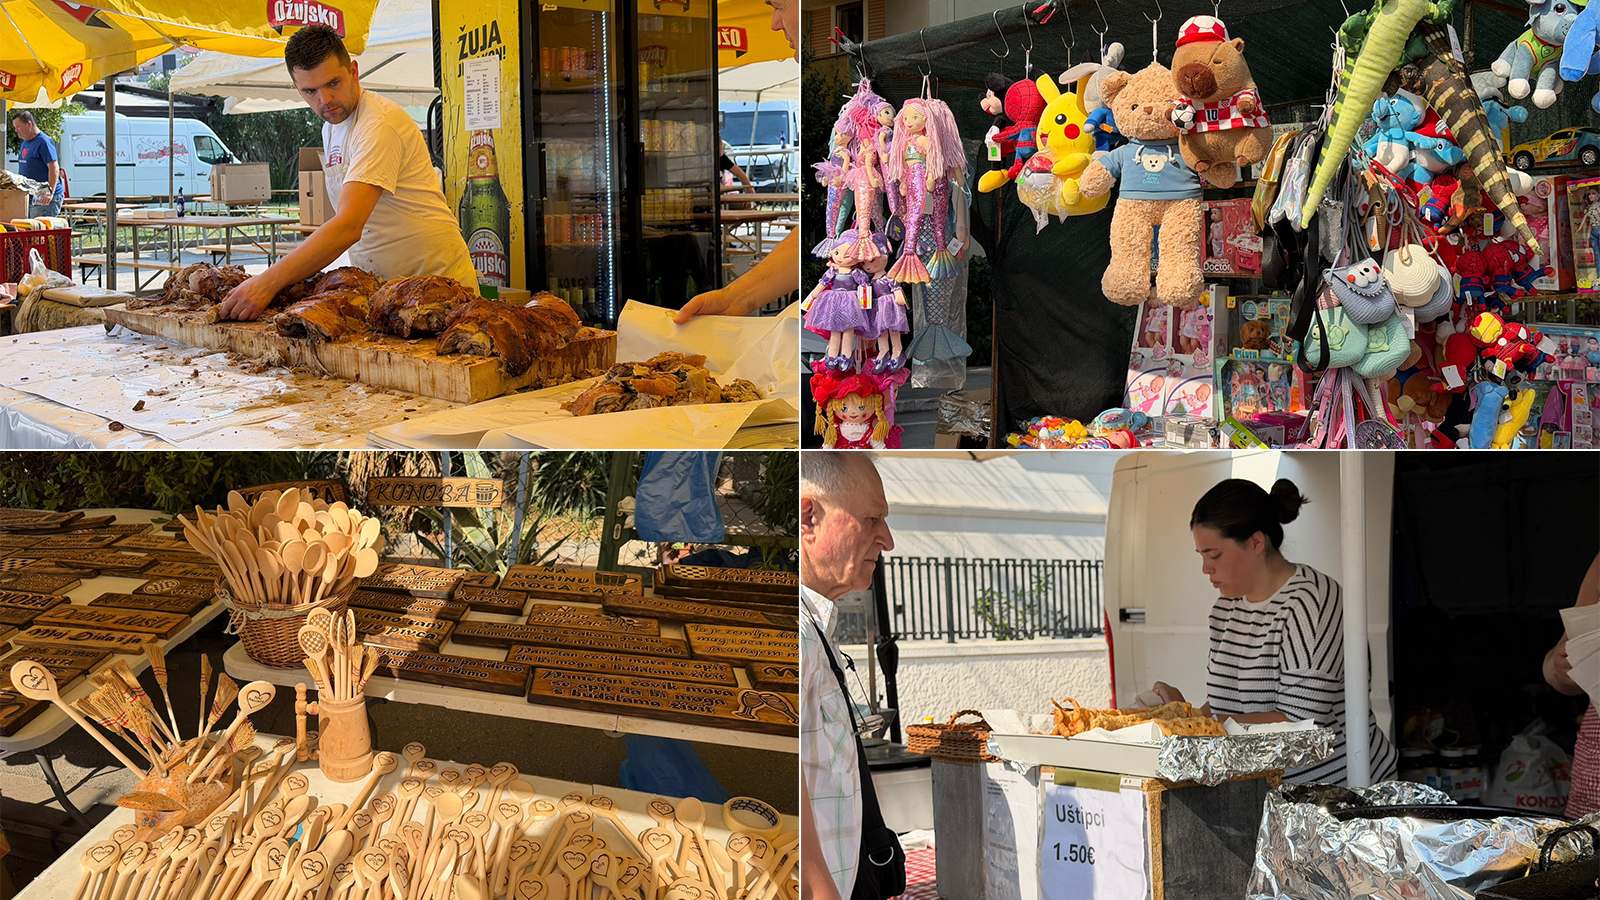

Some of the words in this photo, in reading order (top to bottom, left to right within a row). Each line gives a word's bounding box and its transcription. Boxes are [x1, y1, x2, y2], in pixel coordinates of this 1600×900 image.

[274, 0, 338, 30] Ožujsko
[456, 20, 502, 61] ŽUJA
[1207, 109, 1218, 120] 10
[375, 483, 470, 502] KONOBA
[511, 573, 589, 583] KOMINU
[510, 582, 571, 591] MOGA
[384, 626, 439, 640] pivca
[447, 667, 490, 678] idemo
[571, 688, 661, 707] budalama
[685, 686, 736, 696] mora
[674, 693, 727, 706] moga
[1516, 795, 1567, 808] KONZU
[1055, 804, 1105, 829] Uštipci
[1053, 842, 1095, 865] 1.50€
